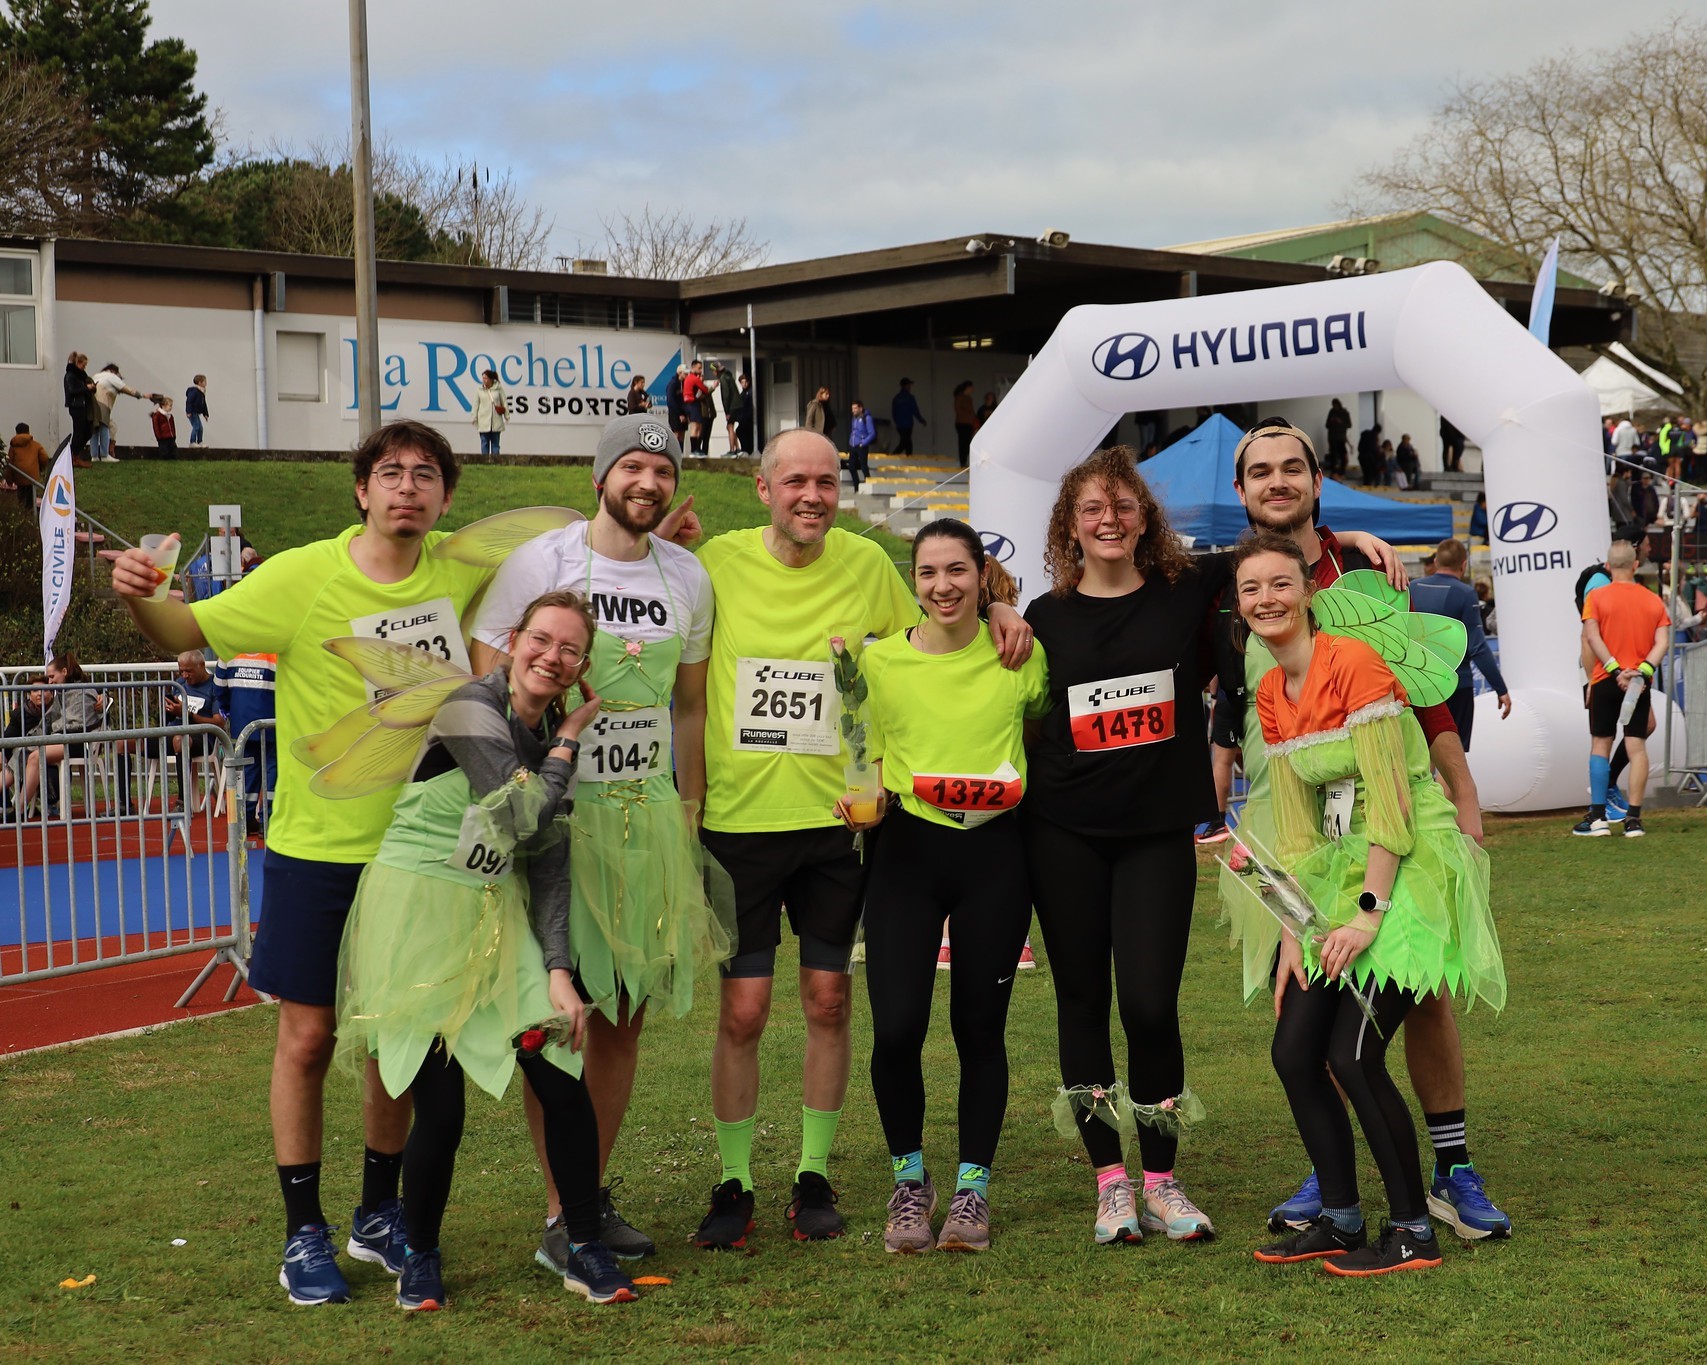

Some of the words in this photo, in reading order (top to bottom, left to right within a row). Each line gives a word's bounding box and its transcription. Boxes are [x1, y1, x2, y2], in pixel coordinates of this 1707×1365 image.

[1172, 310, 1367, 370] HYUNDAI
[343, 338, 411, 411] La
[418, 341, 632, 413] Rochelle
[537, 396, 629, 416] SPORTS
[52, 526, 65, 588] CIVILE
[390, 611, 439, 631] CUBE
[771, 670, 825, 682] CUBE
[750, 688, 823, 721] 2651
[1103, 683, 1156, 700] CUBE
[610, 718, 659, 730] CUBE
[1091, 706, 1165, 743] 1478
[591, 740, 660, 774] 104-2
[932, 779, 1006, 806] 1372
[1325, 790, 1343, 800] BE
